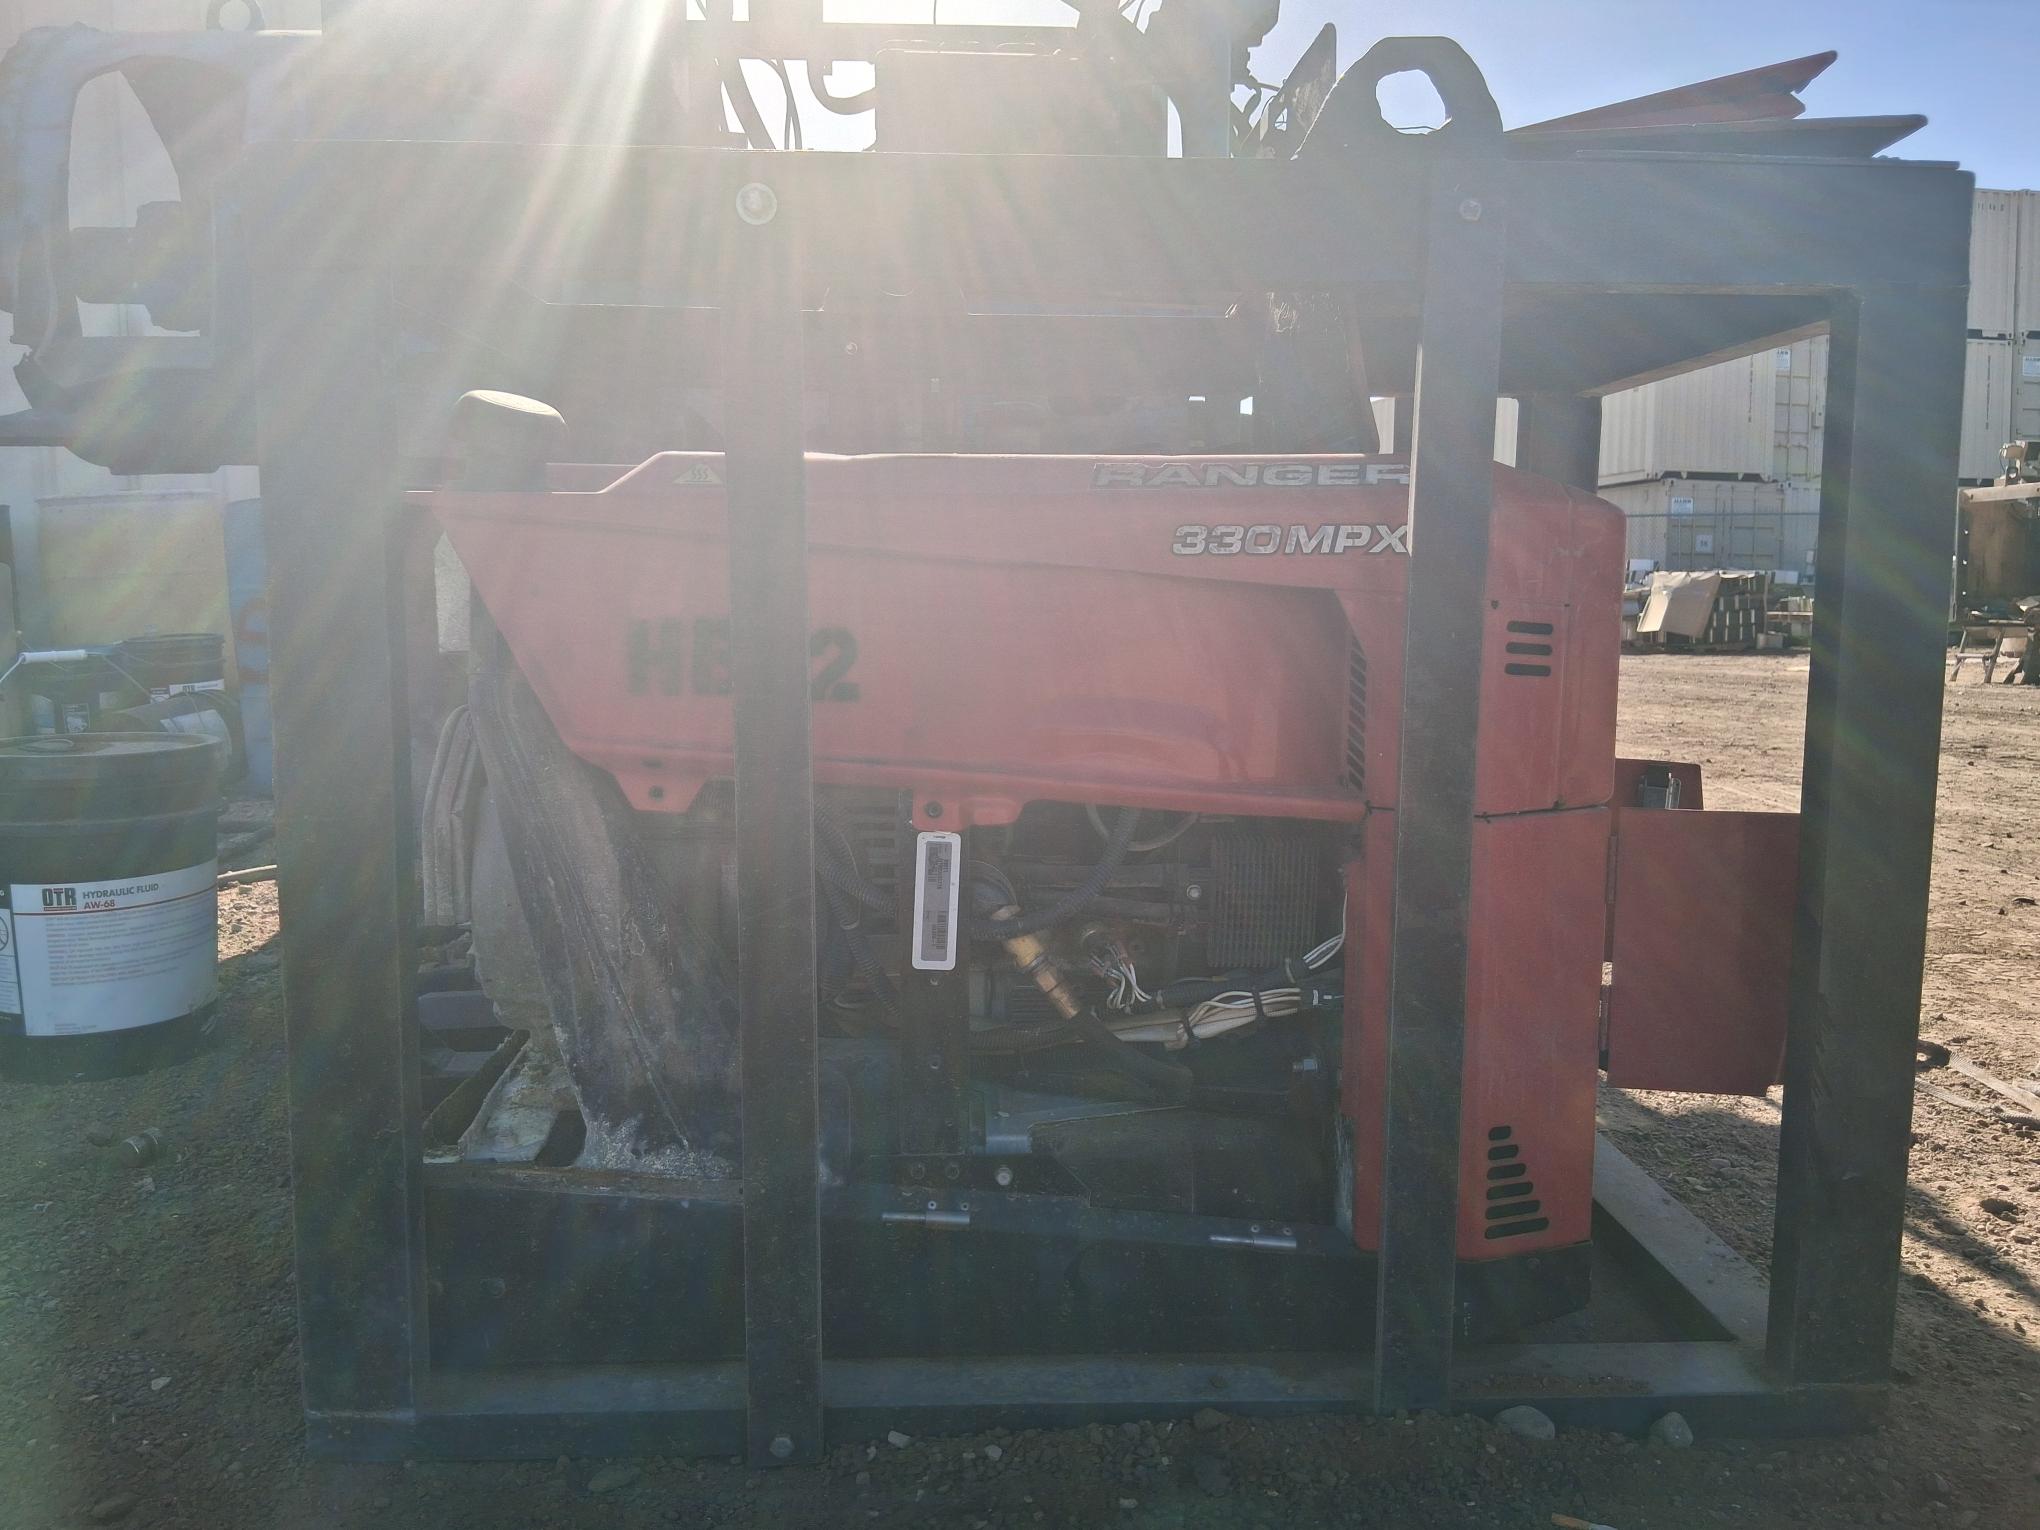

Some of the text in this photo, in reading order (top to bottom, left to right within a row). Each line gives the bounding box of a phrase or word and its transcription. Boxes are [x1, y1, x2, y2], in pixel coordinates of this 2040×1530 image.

[1098, 463, 1410, 487] RANGER
[1172, 524, 1410, 555] 330MPX
[42, 883, 159, 906] OTR HYDRAULIC FLUID
[83, 899, 116, 910] AW-68
